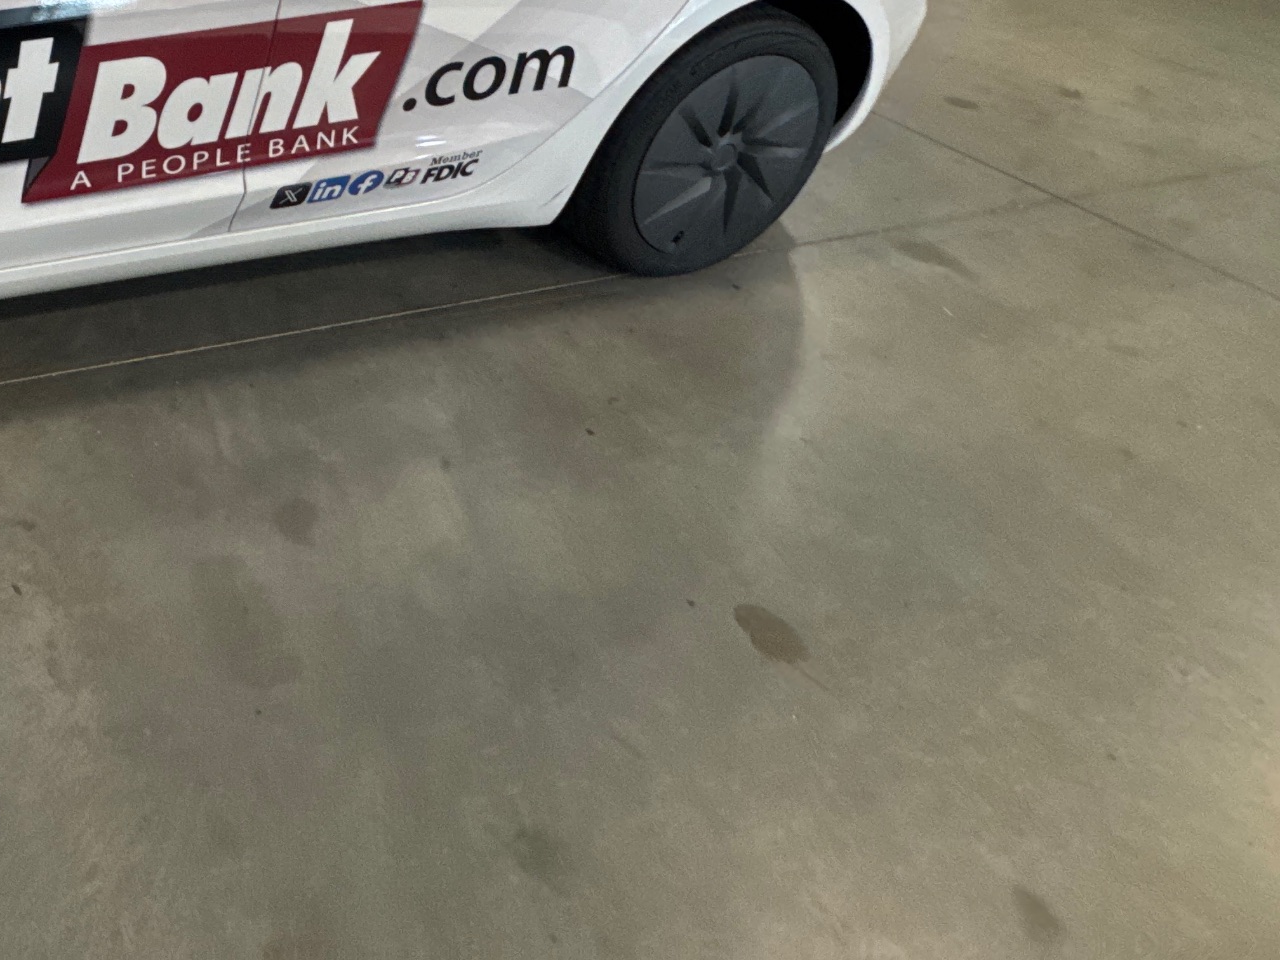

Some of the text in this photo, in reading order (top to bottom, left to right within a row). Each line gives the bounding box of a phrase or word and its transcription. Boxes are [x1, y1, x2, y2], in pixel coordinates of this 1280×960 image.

[402, 45, 576, 113] .com
[70, 126, 359, 191] A PEOPLE BANK
[420, 158, 480, 185] FDIC
[429, 148, 483, 167] Member
